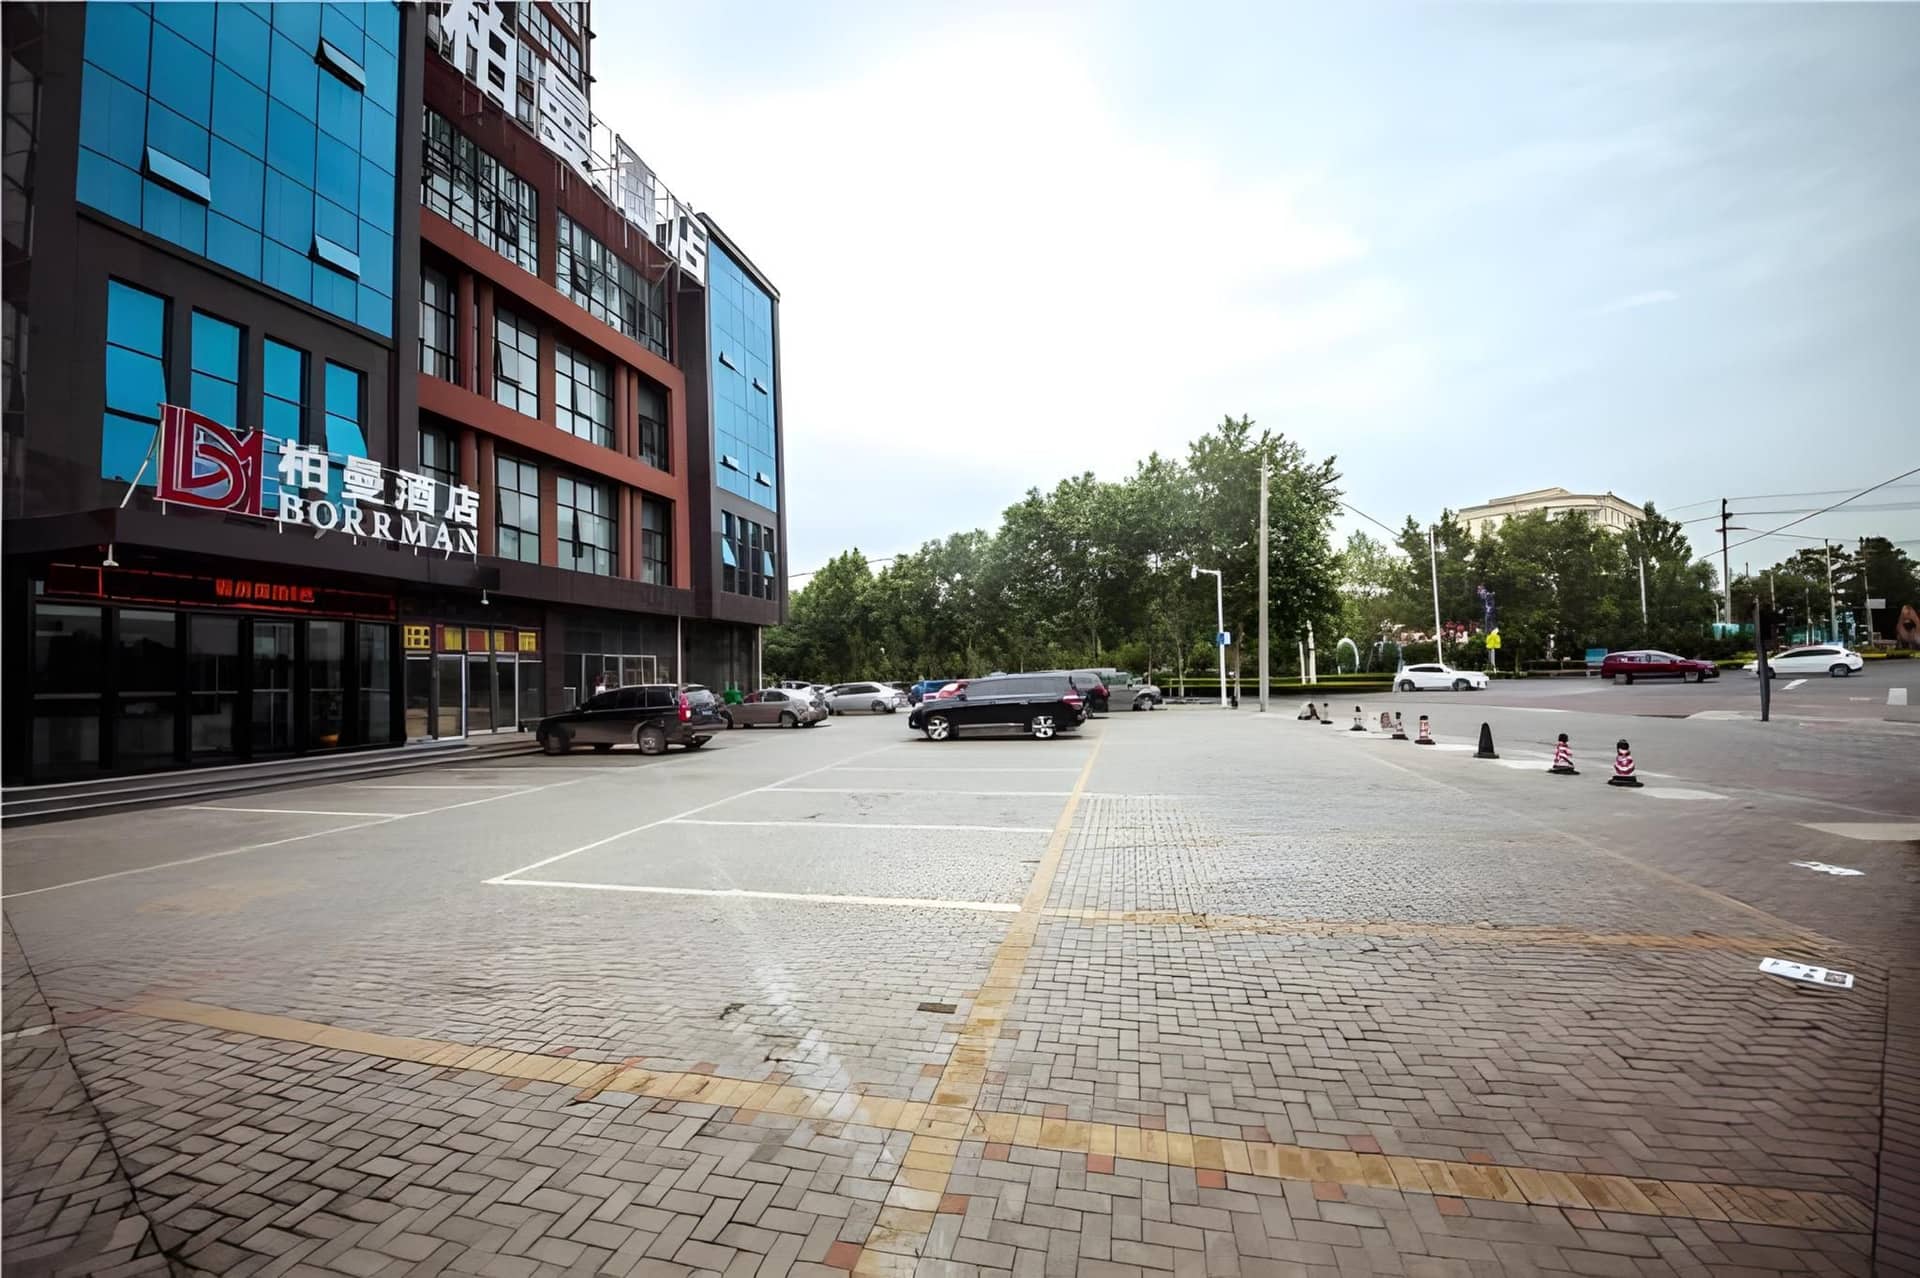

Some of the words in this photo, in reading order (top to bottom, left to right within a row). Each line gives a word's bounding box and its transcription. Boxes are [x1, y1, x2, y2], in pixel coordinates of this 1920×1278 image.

[279, 438, 479, 527] 柏曼酒店
[279, 491, 478, 554] BORRMAN
